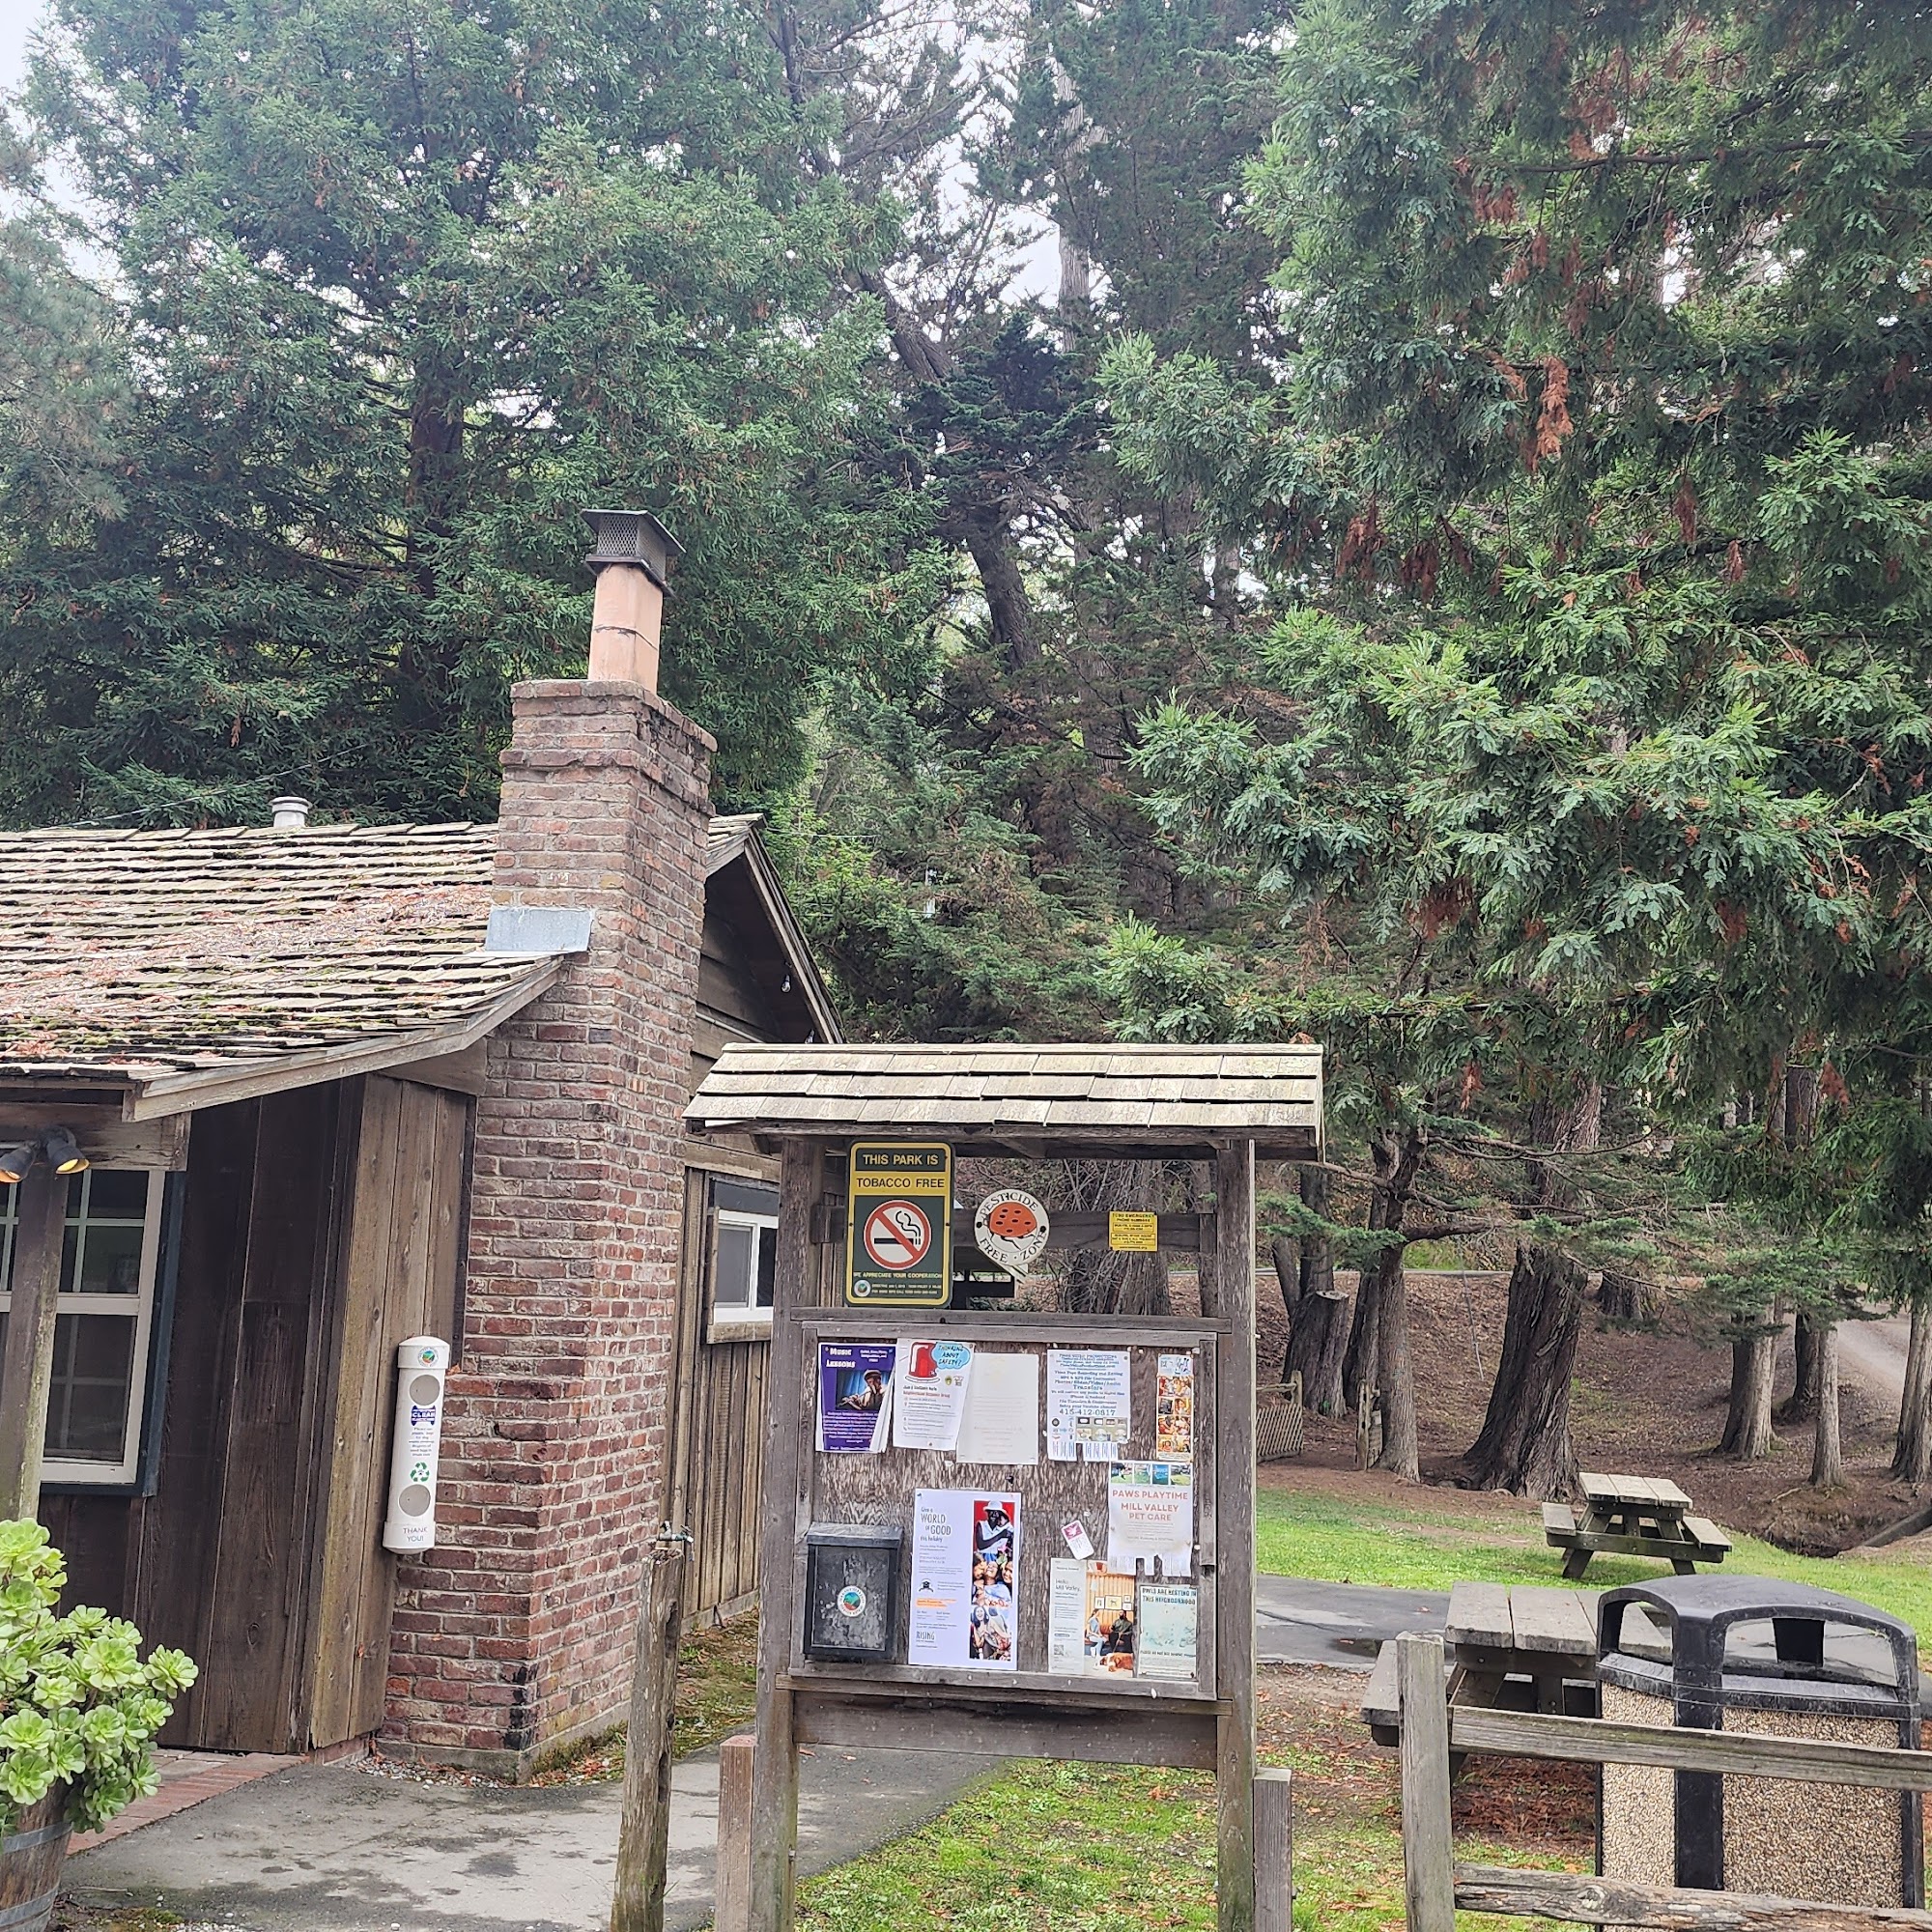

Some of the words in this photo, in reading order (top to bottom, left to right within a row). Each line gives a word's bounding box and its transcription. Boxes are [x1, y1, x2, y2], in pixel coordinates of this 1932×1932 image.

[863, 1154, 890, 1165] THIS
[893, 1154, 923, 1165] PARK
[927, 1154, 938, 1165] IS
[856, 1178, 911, 1188] TOBACCO
[916, 1178, 945, 1188] FREE
[980, 1192, 1038, 1220] PESTICIDE
[980, 1238, 1008, 1263] FREE
[1020, 1231, 1047, 1261] ZONE
[1142, 1491, 1188, 1500] PLAYTIME
[921, 1514, 946, 1524] WORLD
[931, 1526, 951, 1535] GOOD
